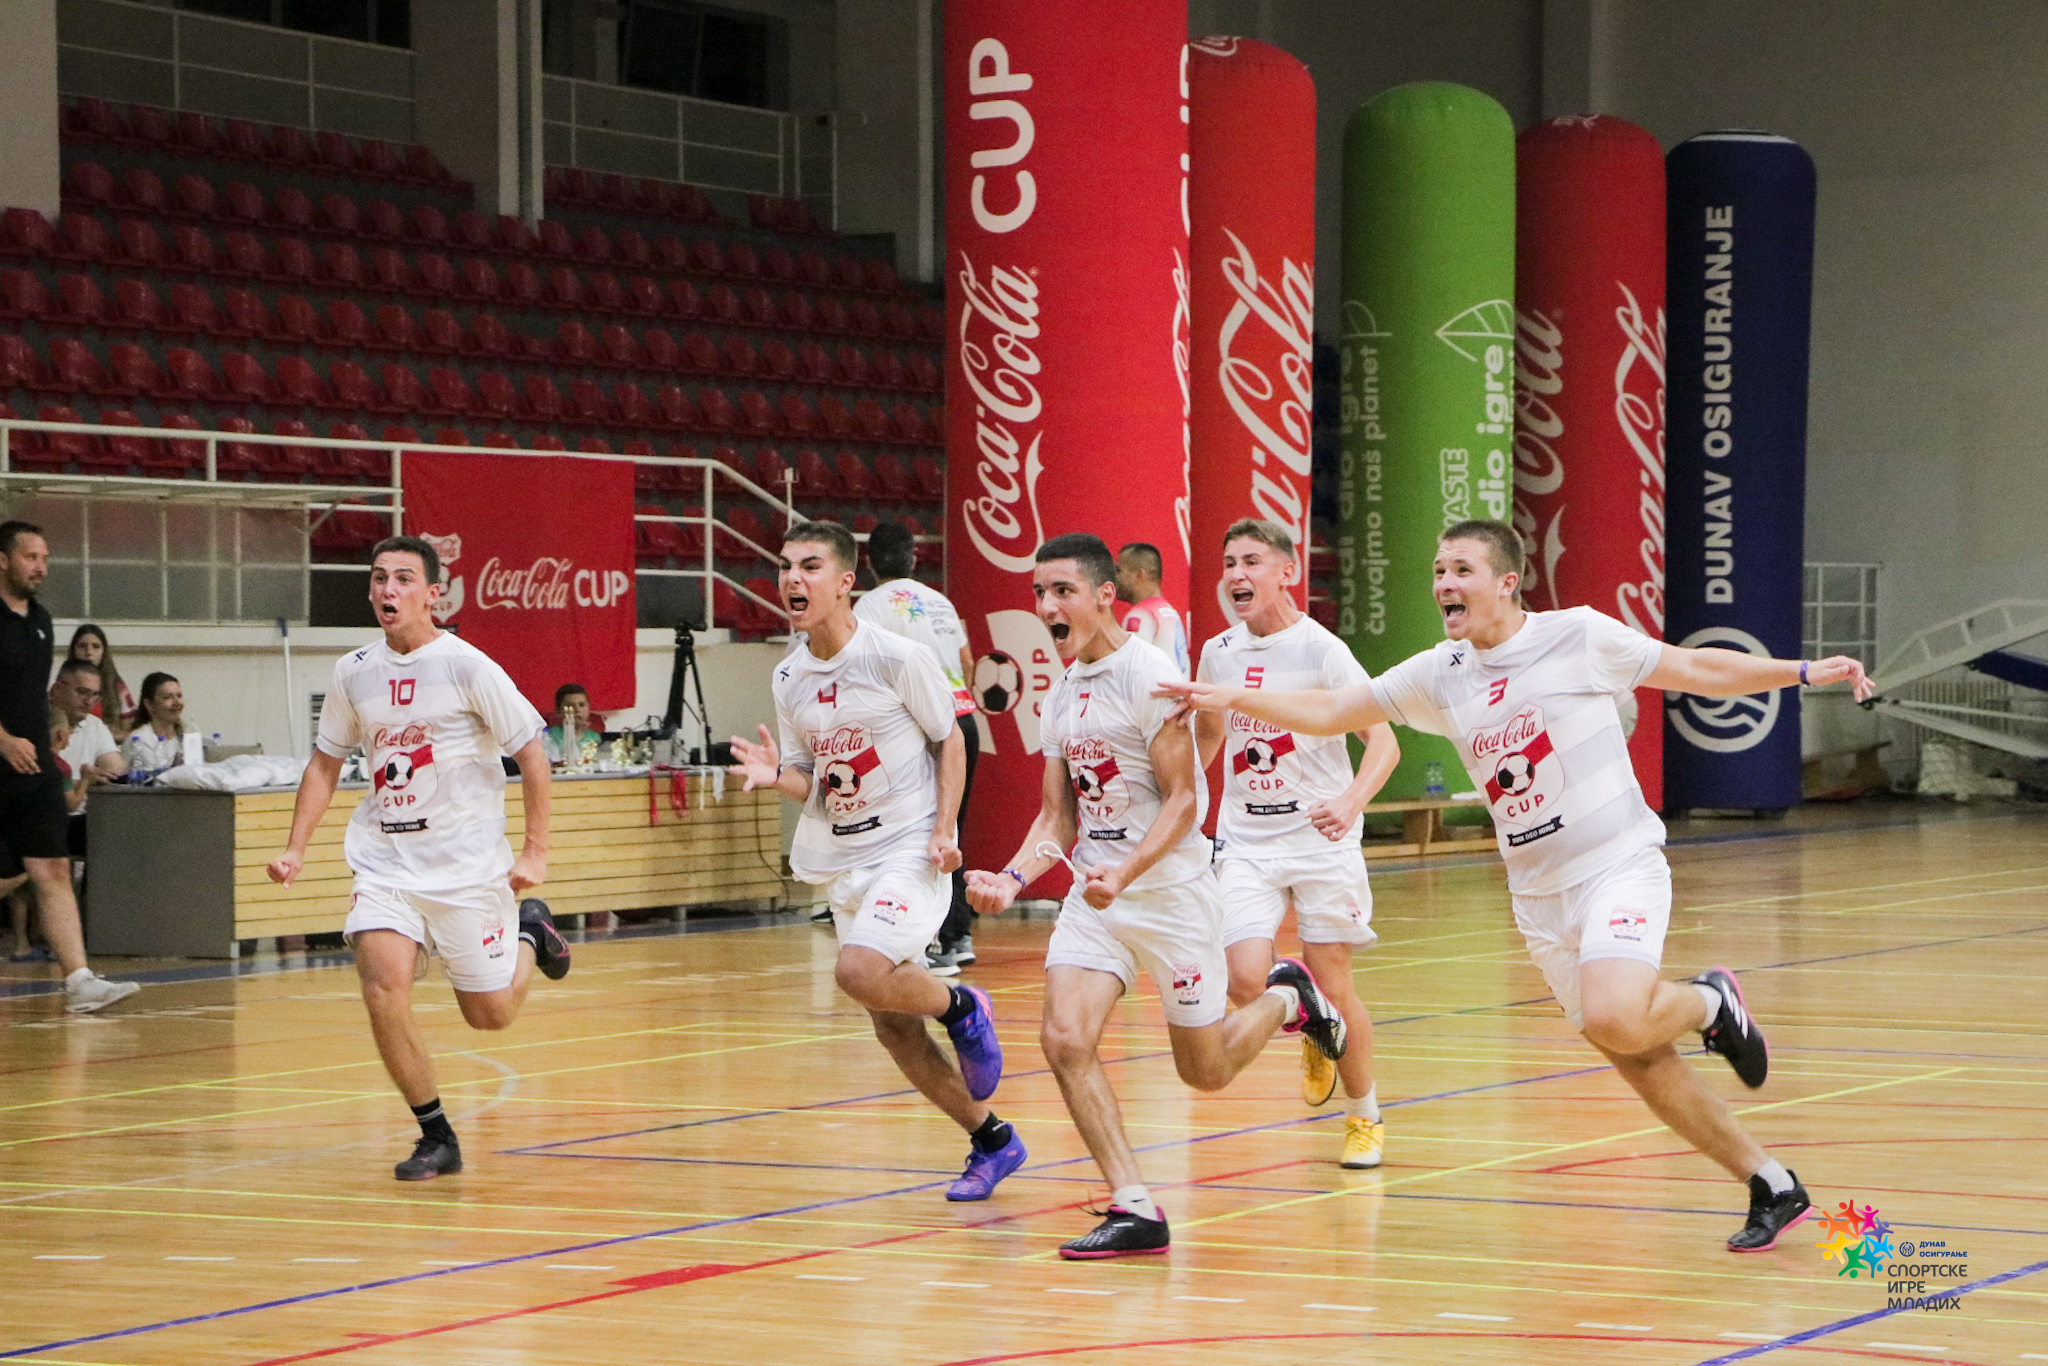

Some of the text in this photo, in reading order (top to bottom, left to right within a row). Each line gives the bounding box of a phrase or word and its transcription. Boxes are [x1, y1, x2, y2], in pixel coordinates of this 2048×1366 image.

[960, 37, 1044, 574] Coca-Cola CUP
[1476, 344, 1510, 435] igre
[1703, 205, 1734, 605] DUNAV OSIGURANJE
[1359, 345, 1390, 636] čuvajmo naš planet
[1439, 448, 1470, 529] ASTE
[476, 556, 630, 610] Coca-Cola CUP
[388, 678, 416, 706] 10
[1244, 666, 1265, 689] 5
[1488, 677, 1509, 706] 3
[817, 681, 838, 709] 4
[1079, 691, 1092, 718] 7
[1472, 708, 1537, 758] Coca-Cola
[1249, 779, 1285, 790] CUP
[383, 794, 416, 808] CUP
[1506, 793, 1545, 818] CUP
